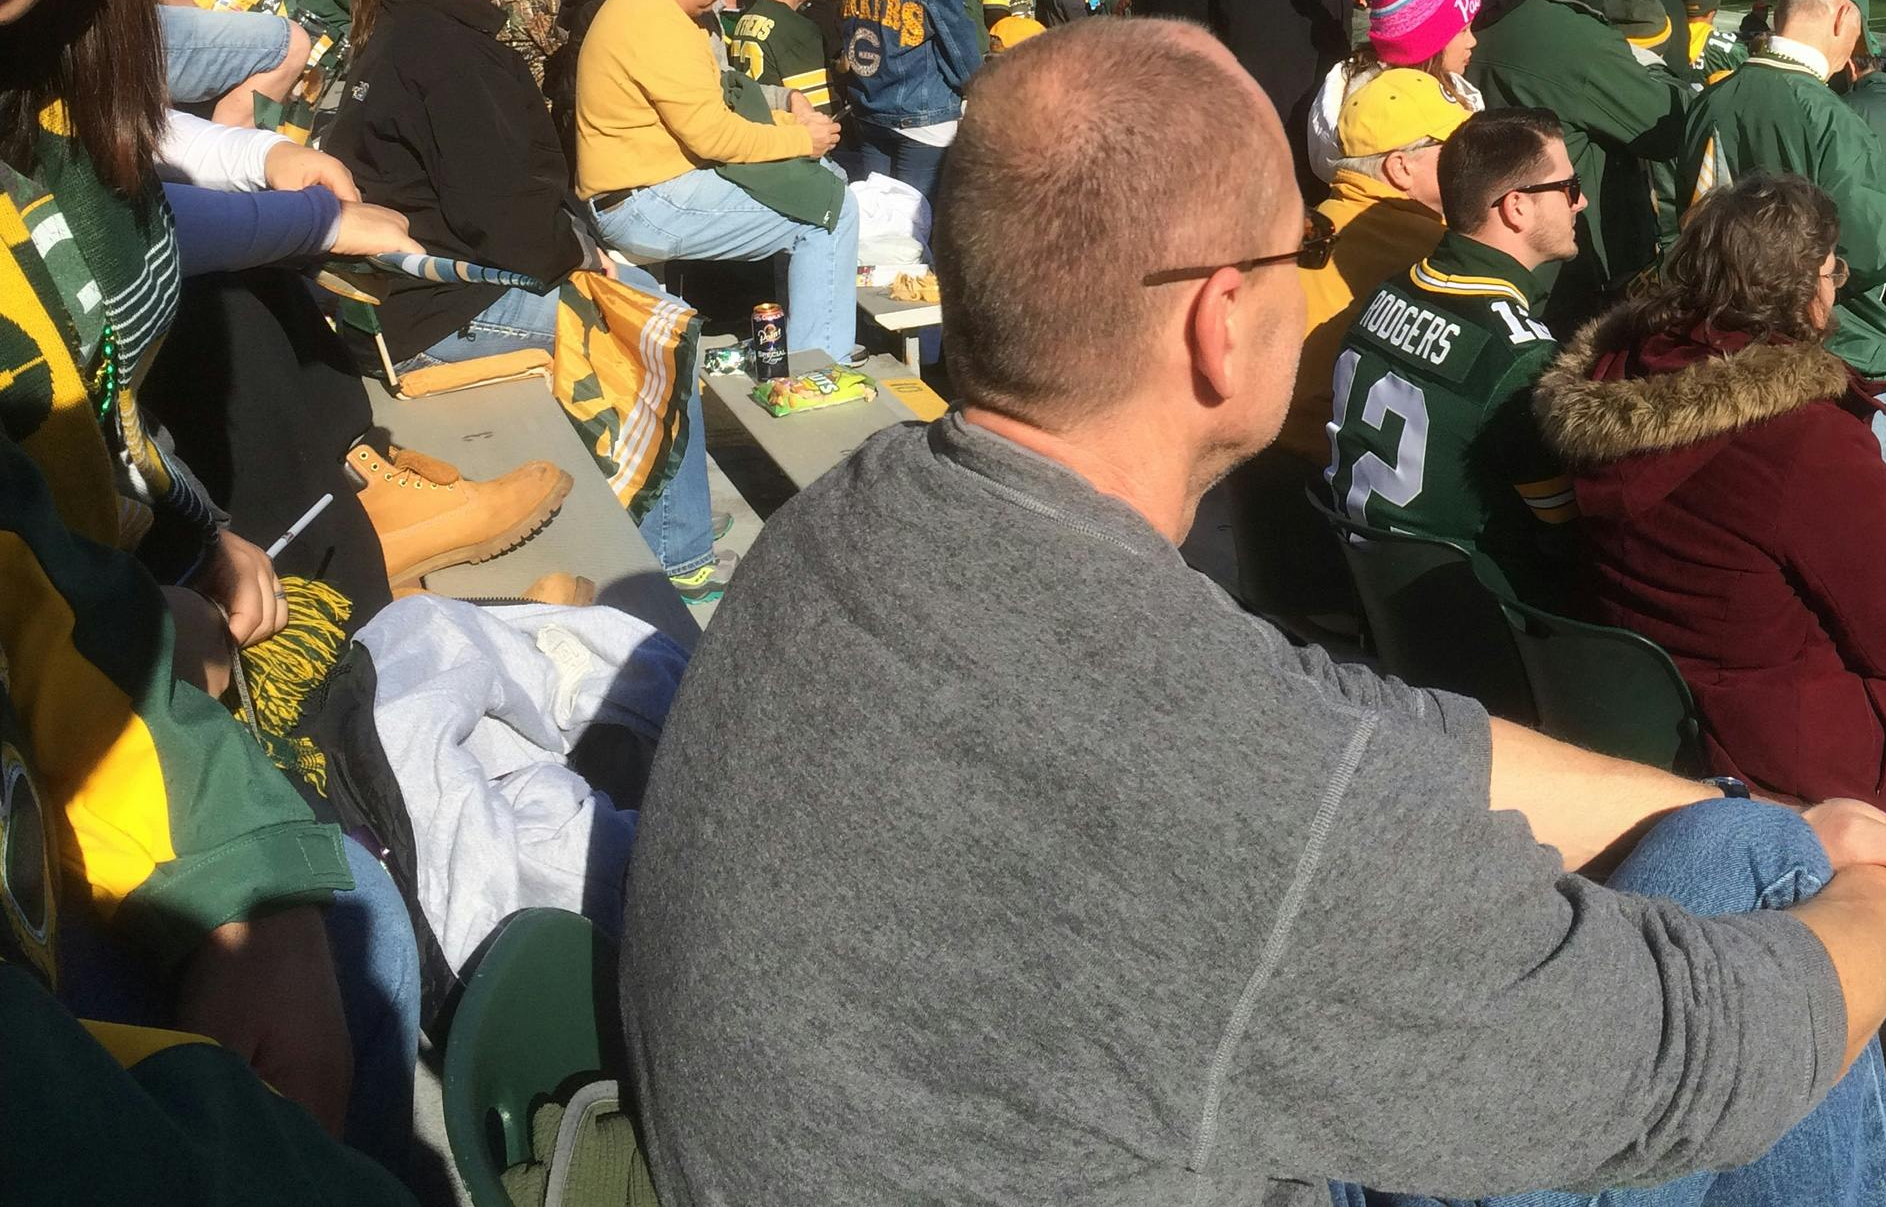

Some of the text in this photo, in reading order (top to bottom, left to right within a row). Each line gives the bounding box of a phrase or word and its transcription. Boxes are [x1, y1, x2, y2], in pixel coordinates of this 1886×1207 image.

[757, 349, 788, 360] SPECIAL
[1360, 289, 1461, 365] RODGERS
[1323, 347, 1430, 531] 12
